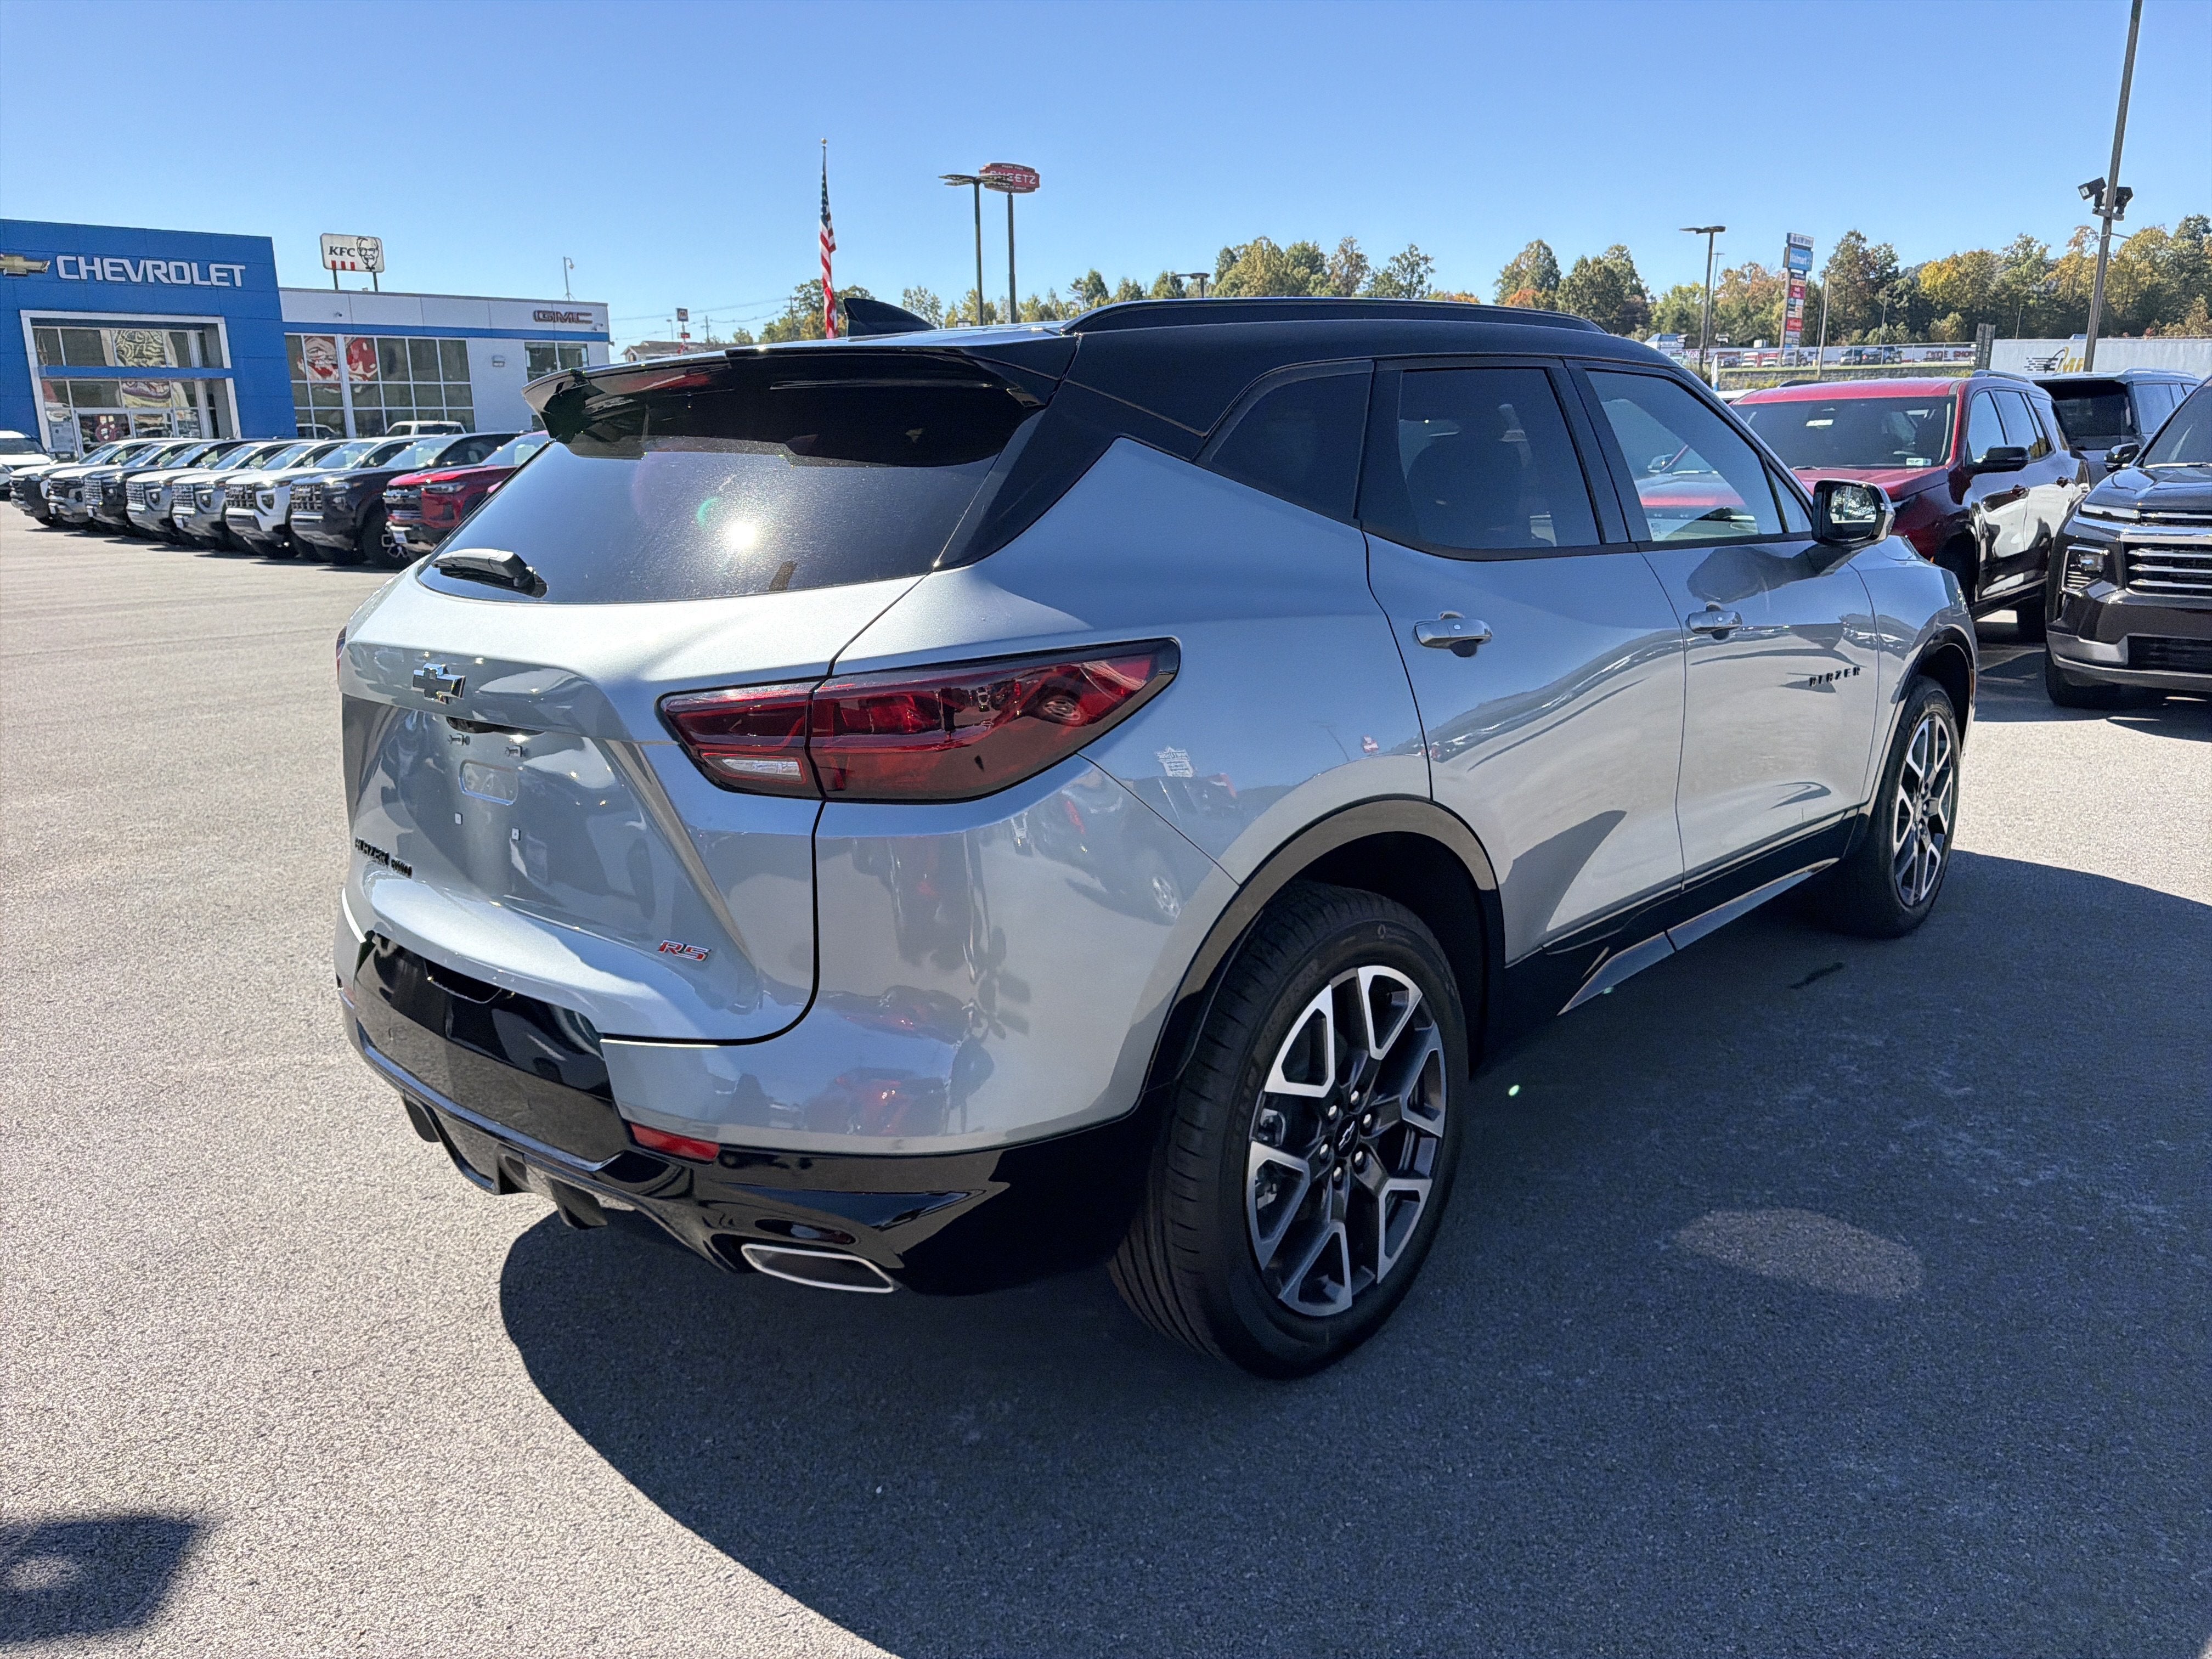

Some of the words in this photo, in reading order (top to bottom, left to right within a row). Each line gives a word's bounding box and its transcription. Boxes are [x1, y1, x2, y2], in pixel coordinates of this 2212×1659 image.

[329, 246, 356, 257] KFC
[56, 255, 246, 287] CHEVROLET
[533, 310, 593, 325] GMC
[658, 940, 712, 961] RS
